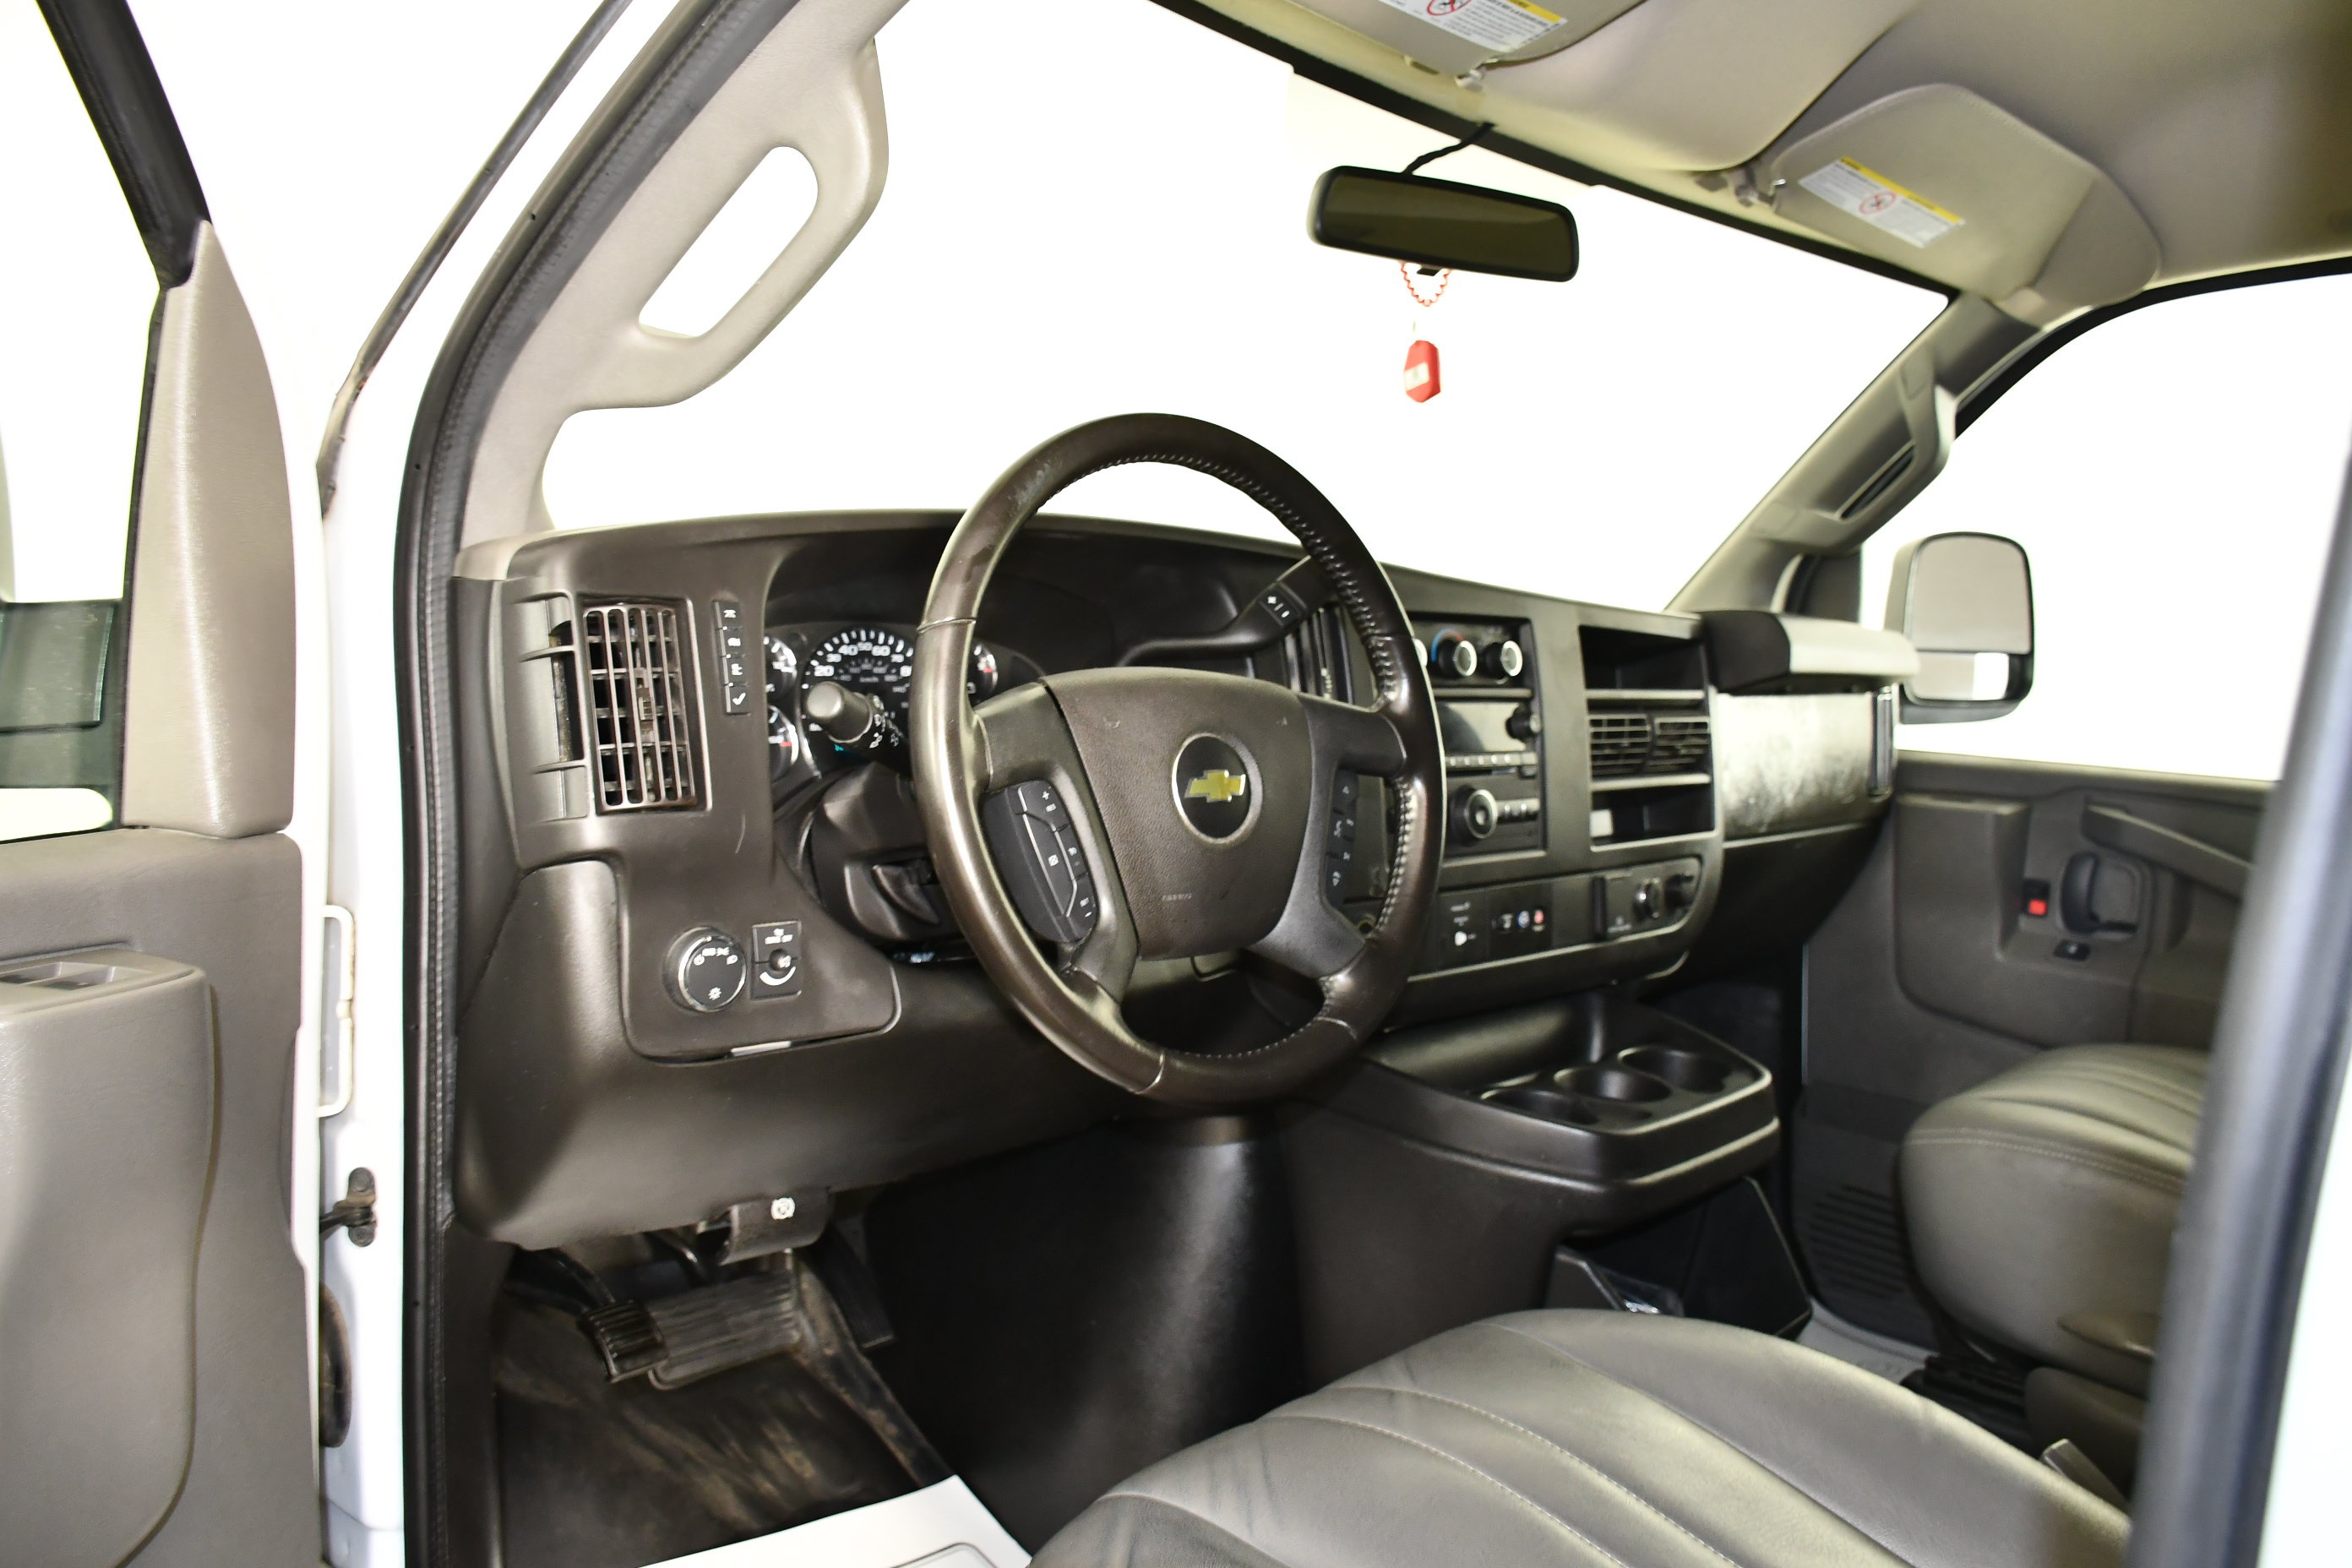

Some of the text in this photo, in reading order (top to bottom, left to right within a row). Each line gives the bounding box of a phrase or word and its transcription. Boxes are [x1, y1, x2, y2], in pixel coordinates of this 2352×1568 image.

[838, 645, 858, 656] 40
[872, 645, 890, 656] 60
[814, 665, 834, 677] 20
